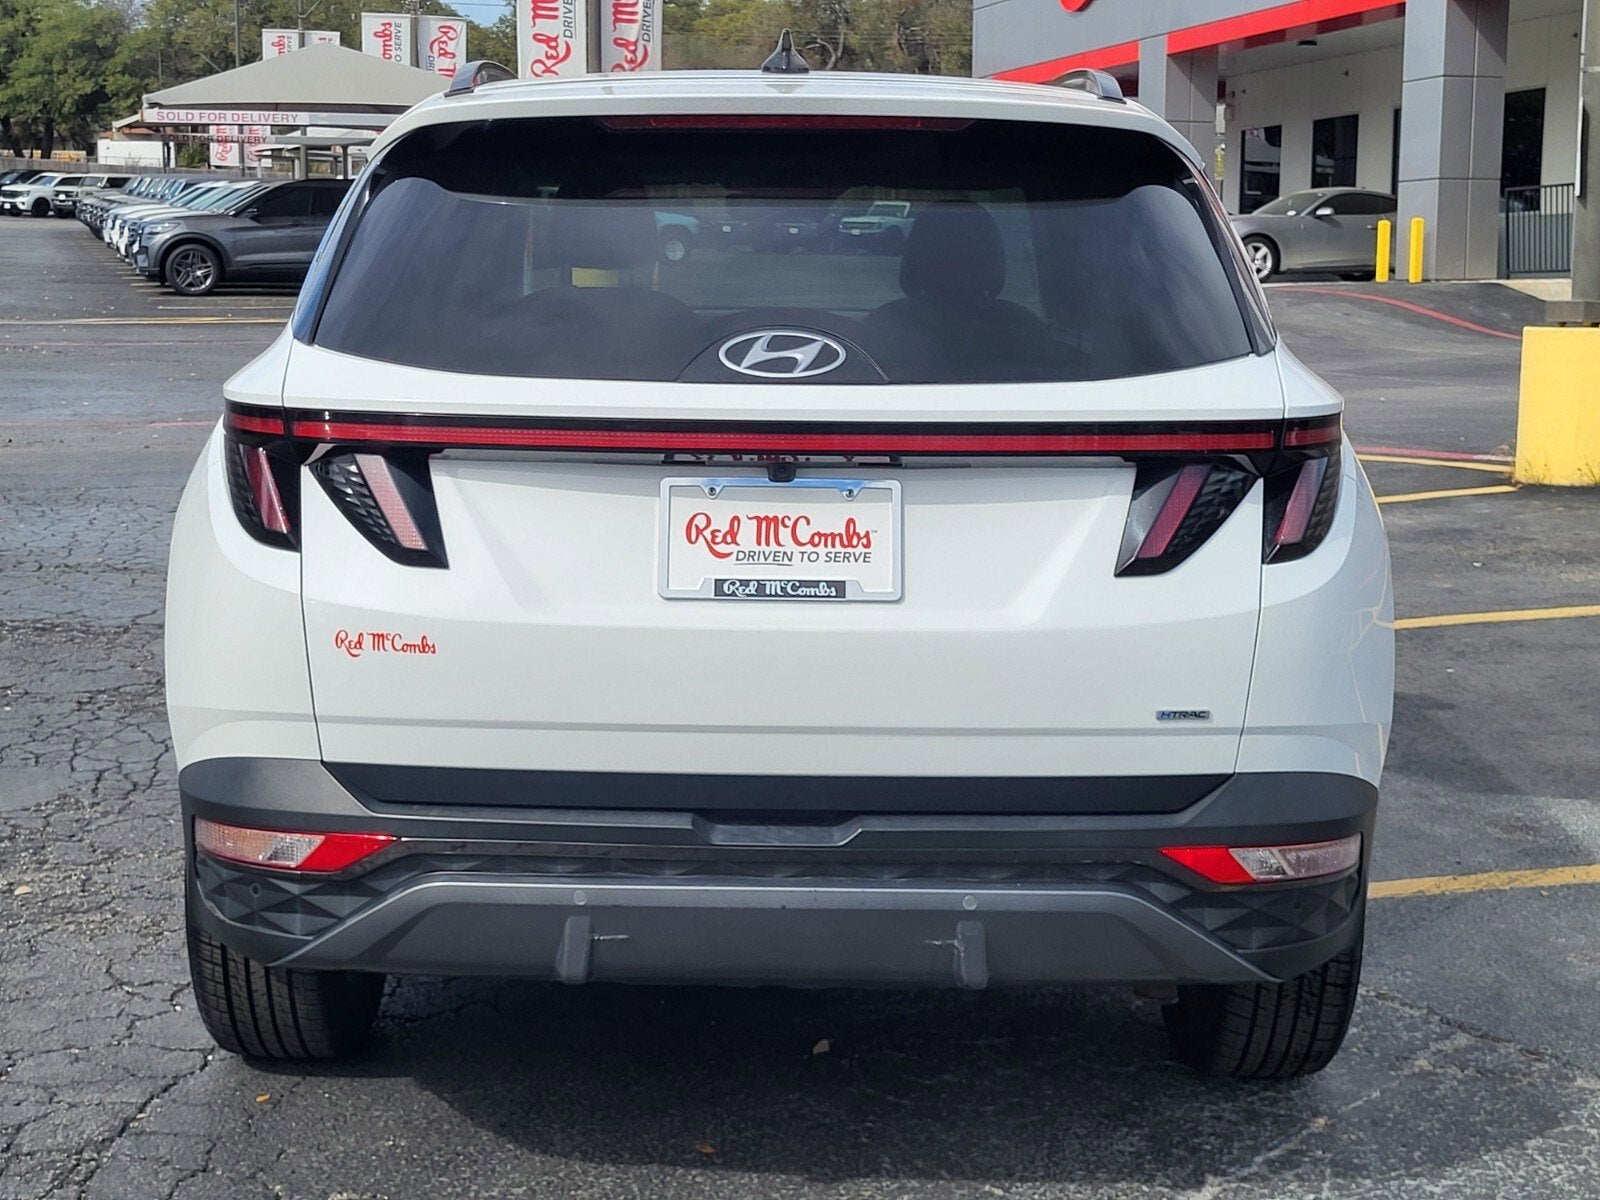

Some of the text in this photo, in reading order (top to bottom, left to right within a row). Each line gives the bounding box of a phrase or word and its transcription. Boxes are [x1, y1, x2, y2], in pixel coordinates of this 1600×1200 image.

[563, 0, 573, 39] DRIVE
[642, 0, 652, 43] DRIVE
[373, 21, 392, 60] ombs
[394, 22, 402, 52] SERVE
[429, 24, 458, 59] Red
[530, 33, 571, 78] Red
[156, 111, 299, 123] SOLD FOR DELIVERY
[193, 135, 214, 144] FOR
[217, 135, 267, 144] DELIVERY
[685, 512, 741, 559] Red
[735, 550, 872, 563] DRIVEN TO SERVE
[723, 580, 837, 598] Red McCombs
[335, 629, 437, 658] Red McCombs
[1159, 710, 1207, 719] HTRAC
